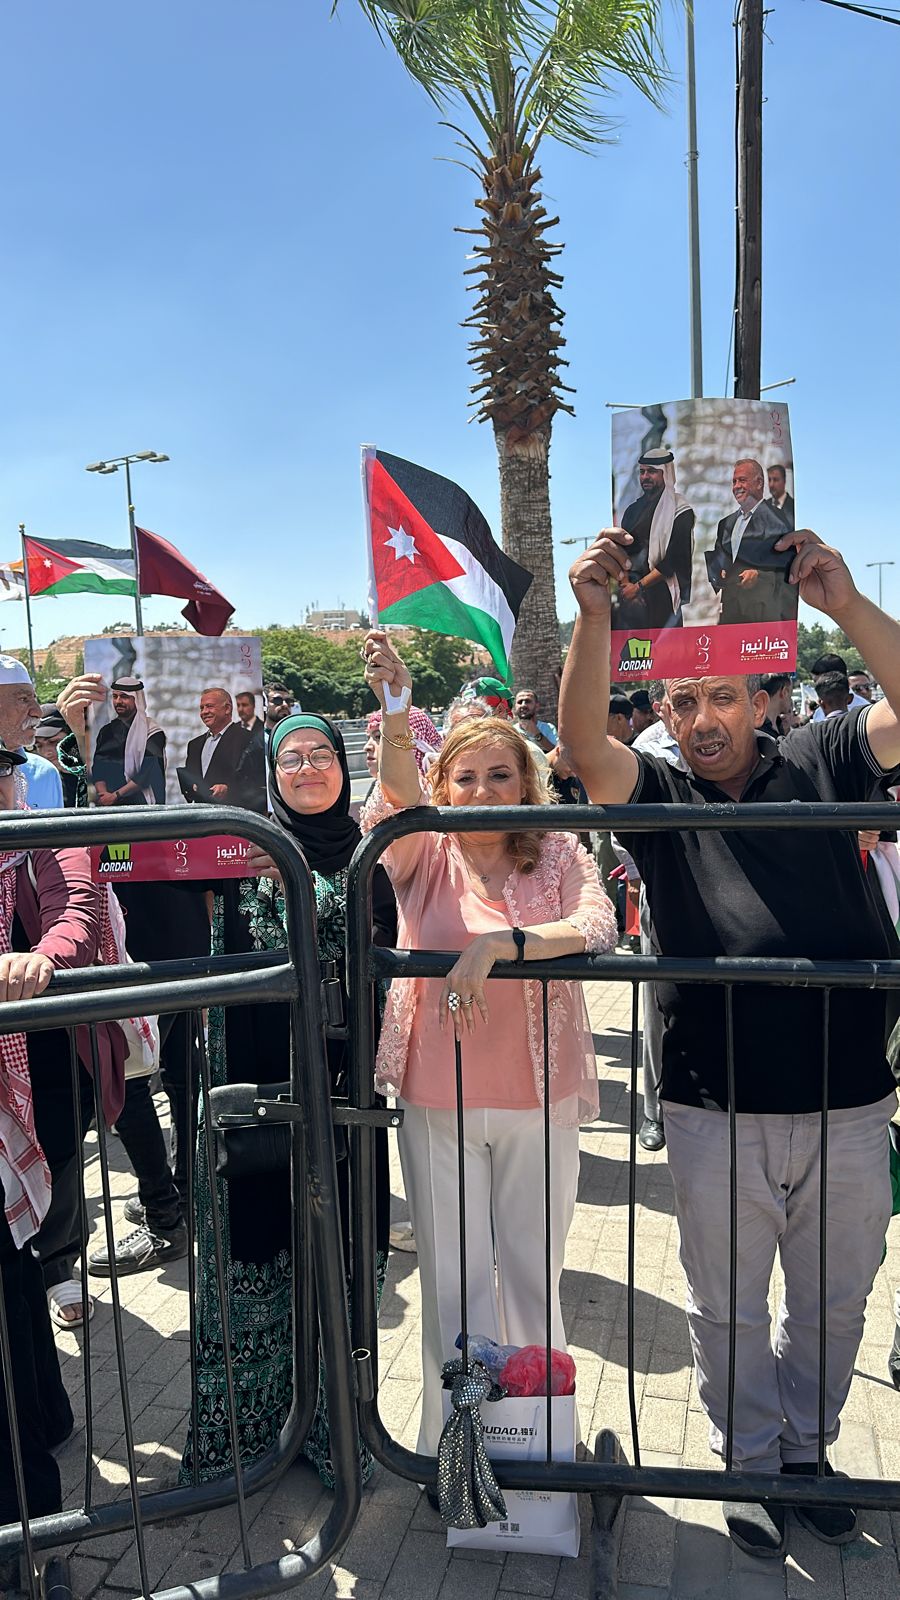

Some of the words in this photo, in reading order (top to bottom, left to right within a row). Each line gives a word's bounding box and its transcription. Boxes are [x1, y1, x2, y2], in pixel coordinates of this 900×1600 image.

[740, 639, 763, 654] نيوز
[765, 636, 789, 652] جفرا
[618, 659, 653, 672] JORDAN
[216, 846, 237, 859] نيوز
[98, 861, 133, 873] JORDAN
